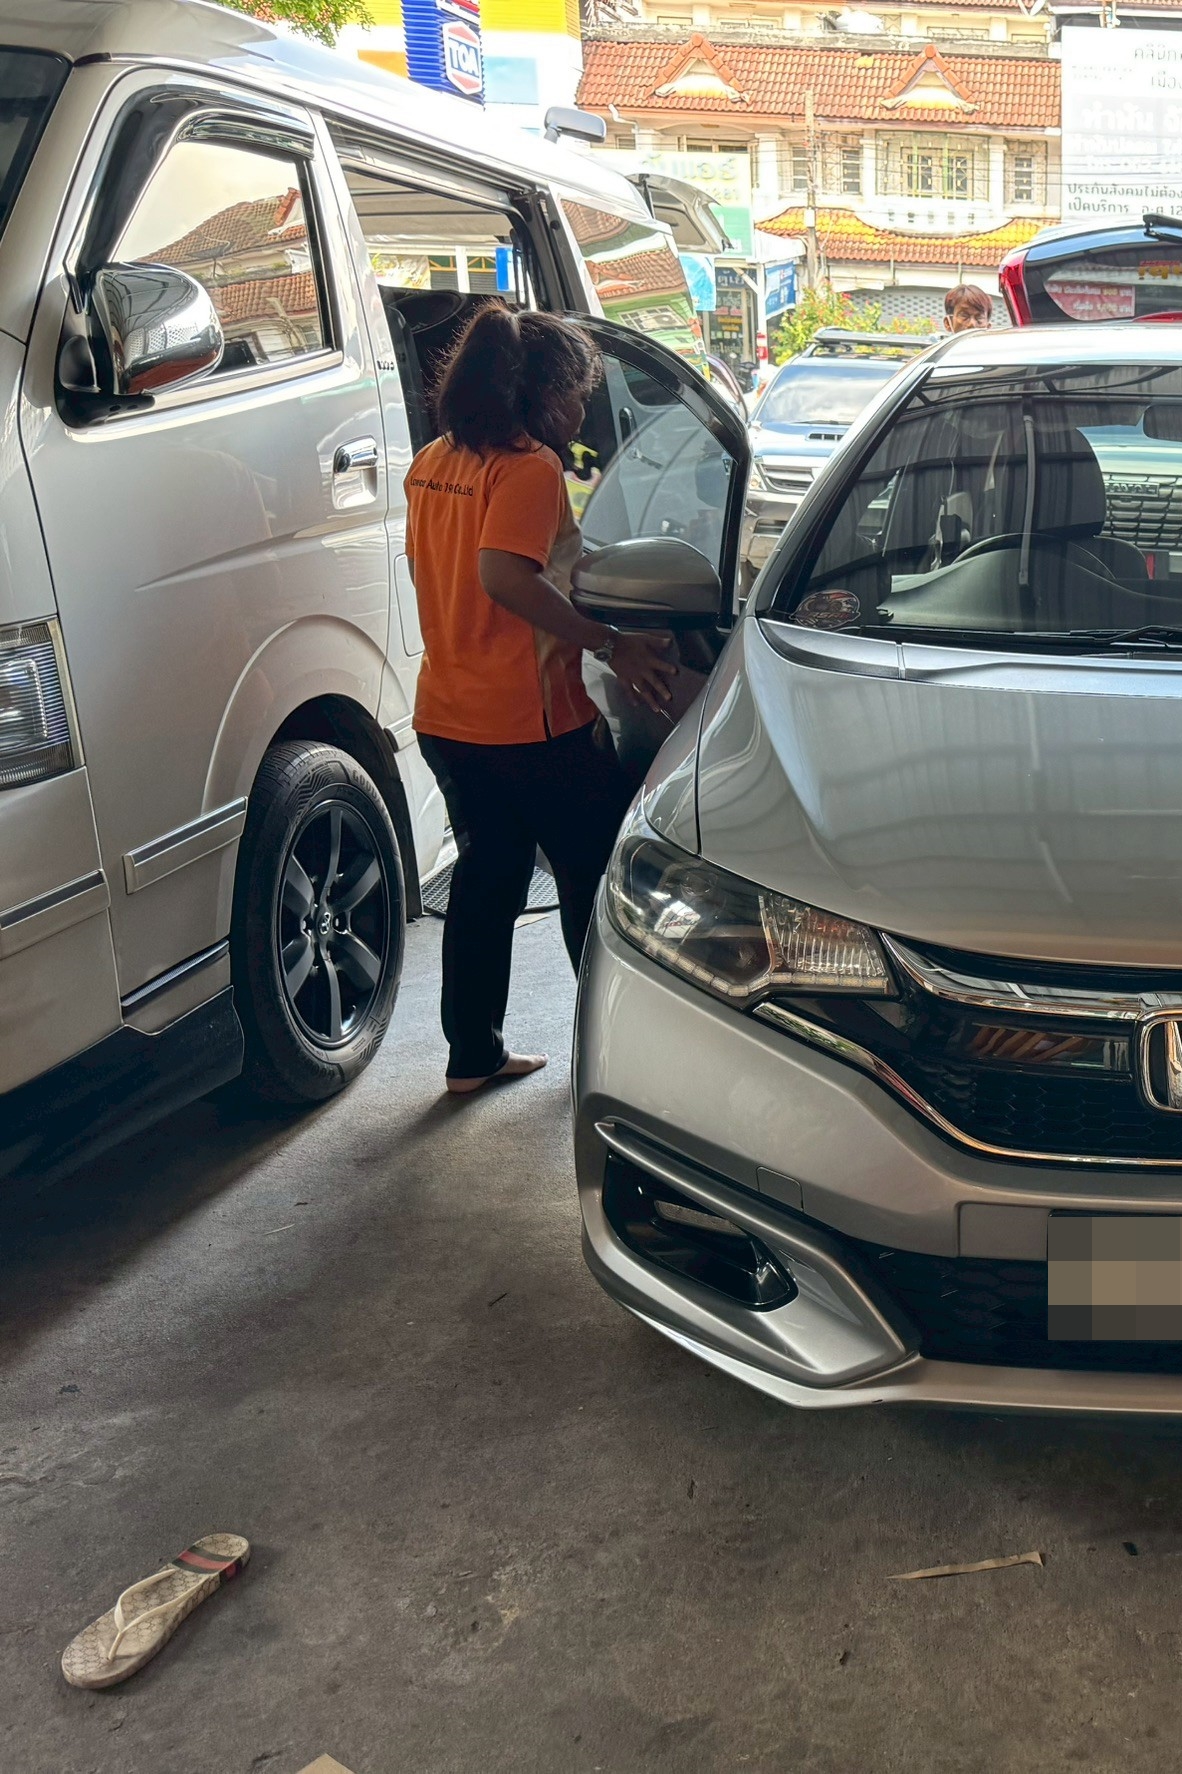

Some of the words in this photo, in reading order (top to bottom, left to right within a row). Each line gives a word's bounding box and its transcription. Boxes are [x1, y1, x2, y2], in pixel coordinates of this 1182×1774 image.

[449, 41, 480, 77] TOA
[1068, 197, 1129, 214] เปิดบริการ
